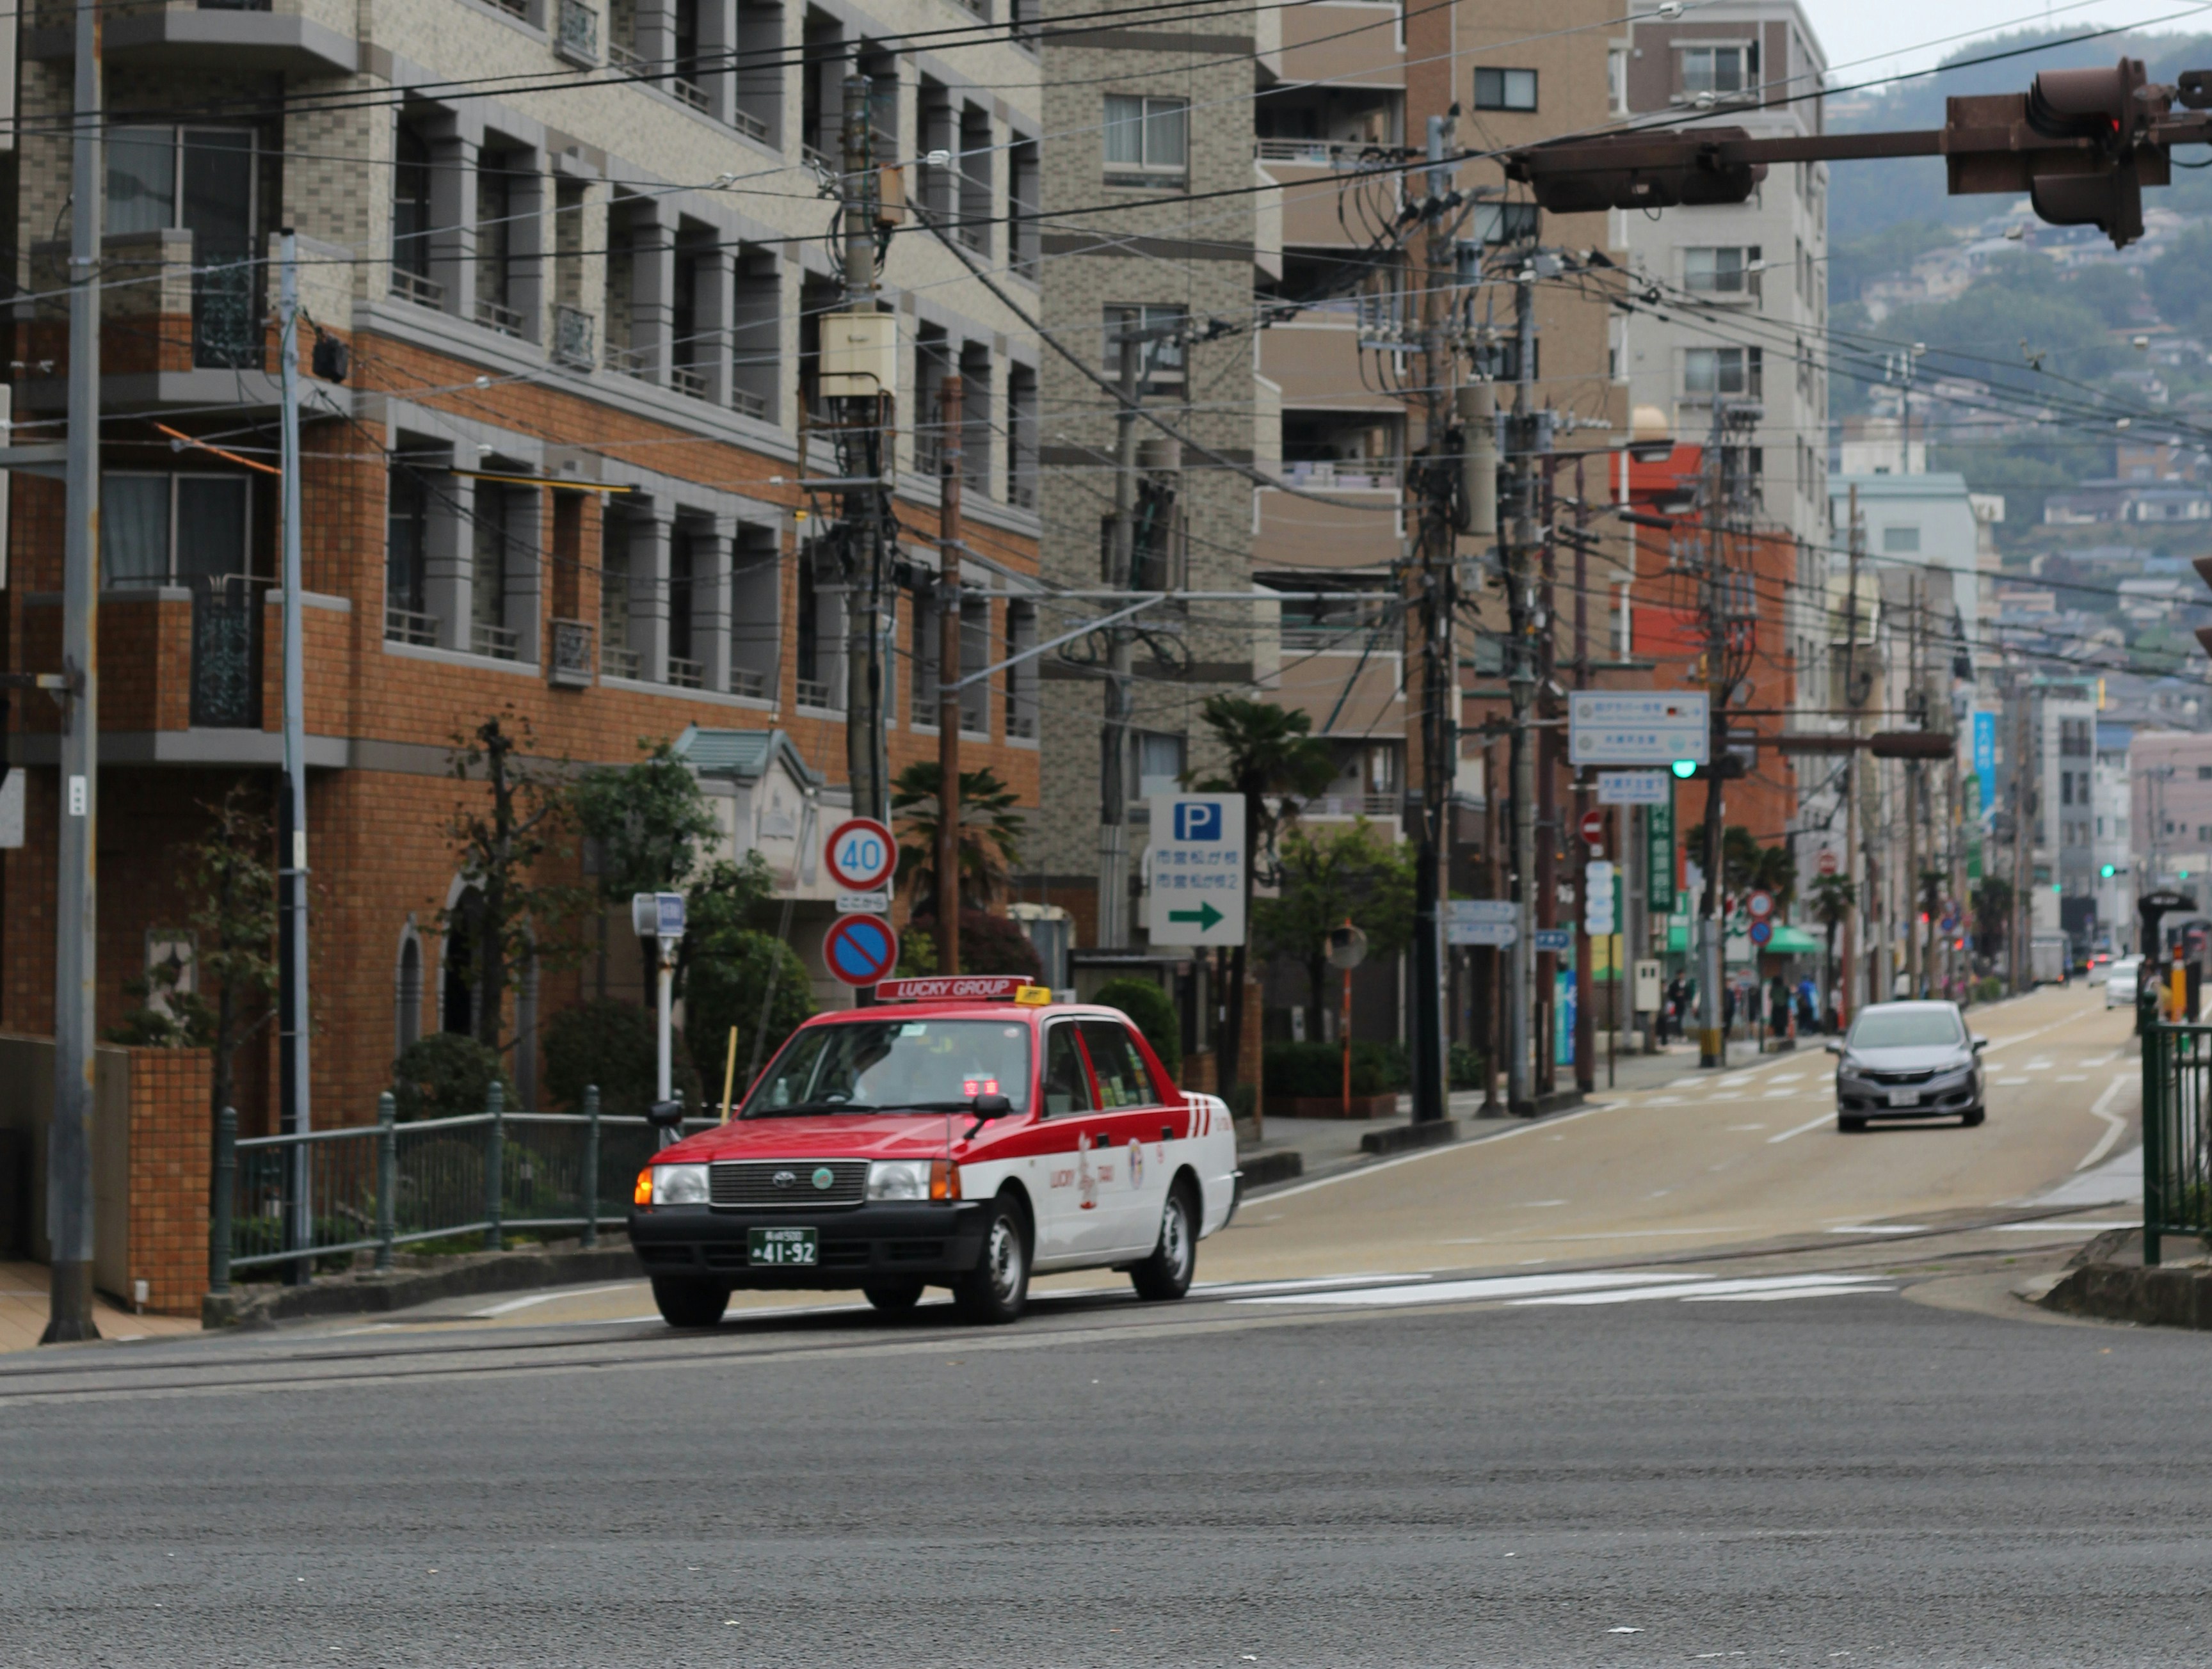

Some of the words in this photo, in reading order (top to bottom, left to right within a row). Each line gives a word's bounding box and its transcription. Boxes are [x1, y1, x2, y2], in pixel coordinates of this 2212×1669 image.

[1184, 805, 1211, 840] P
[842, 840, 880, 870] 40
[897, 982, 951, 996] LUCKY
[953, 980, 1010, 995] GROUP
[763, 1242, 814, 1263] 41-92
